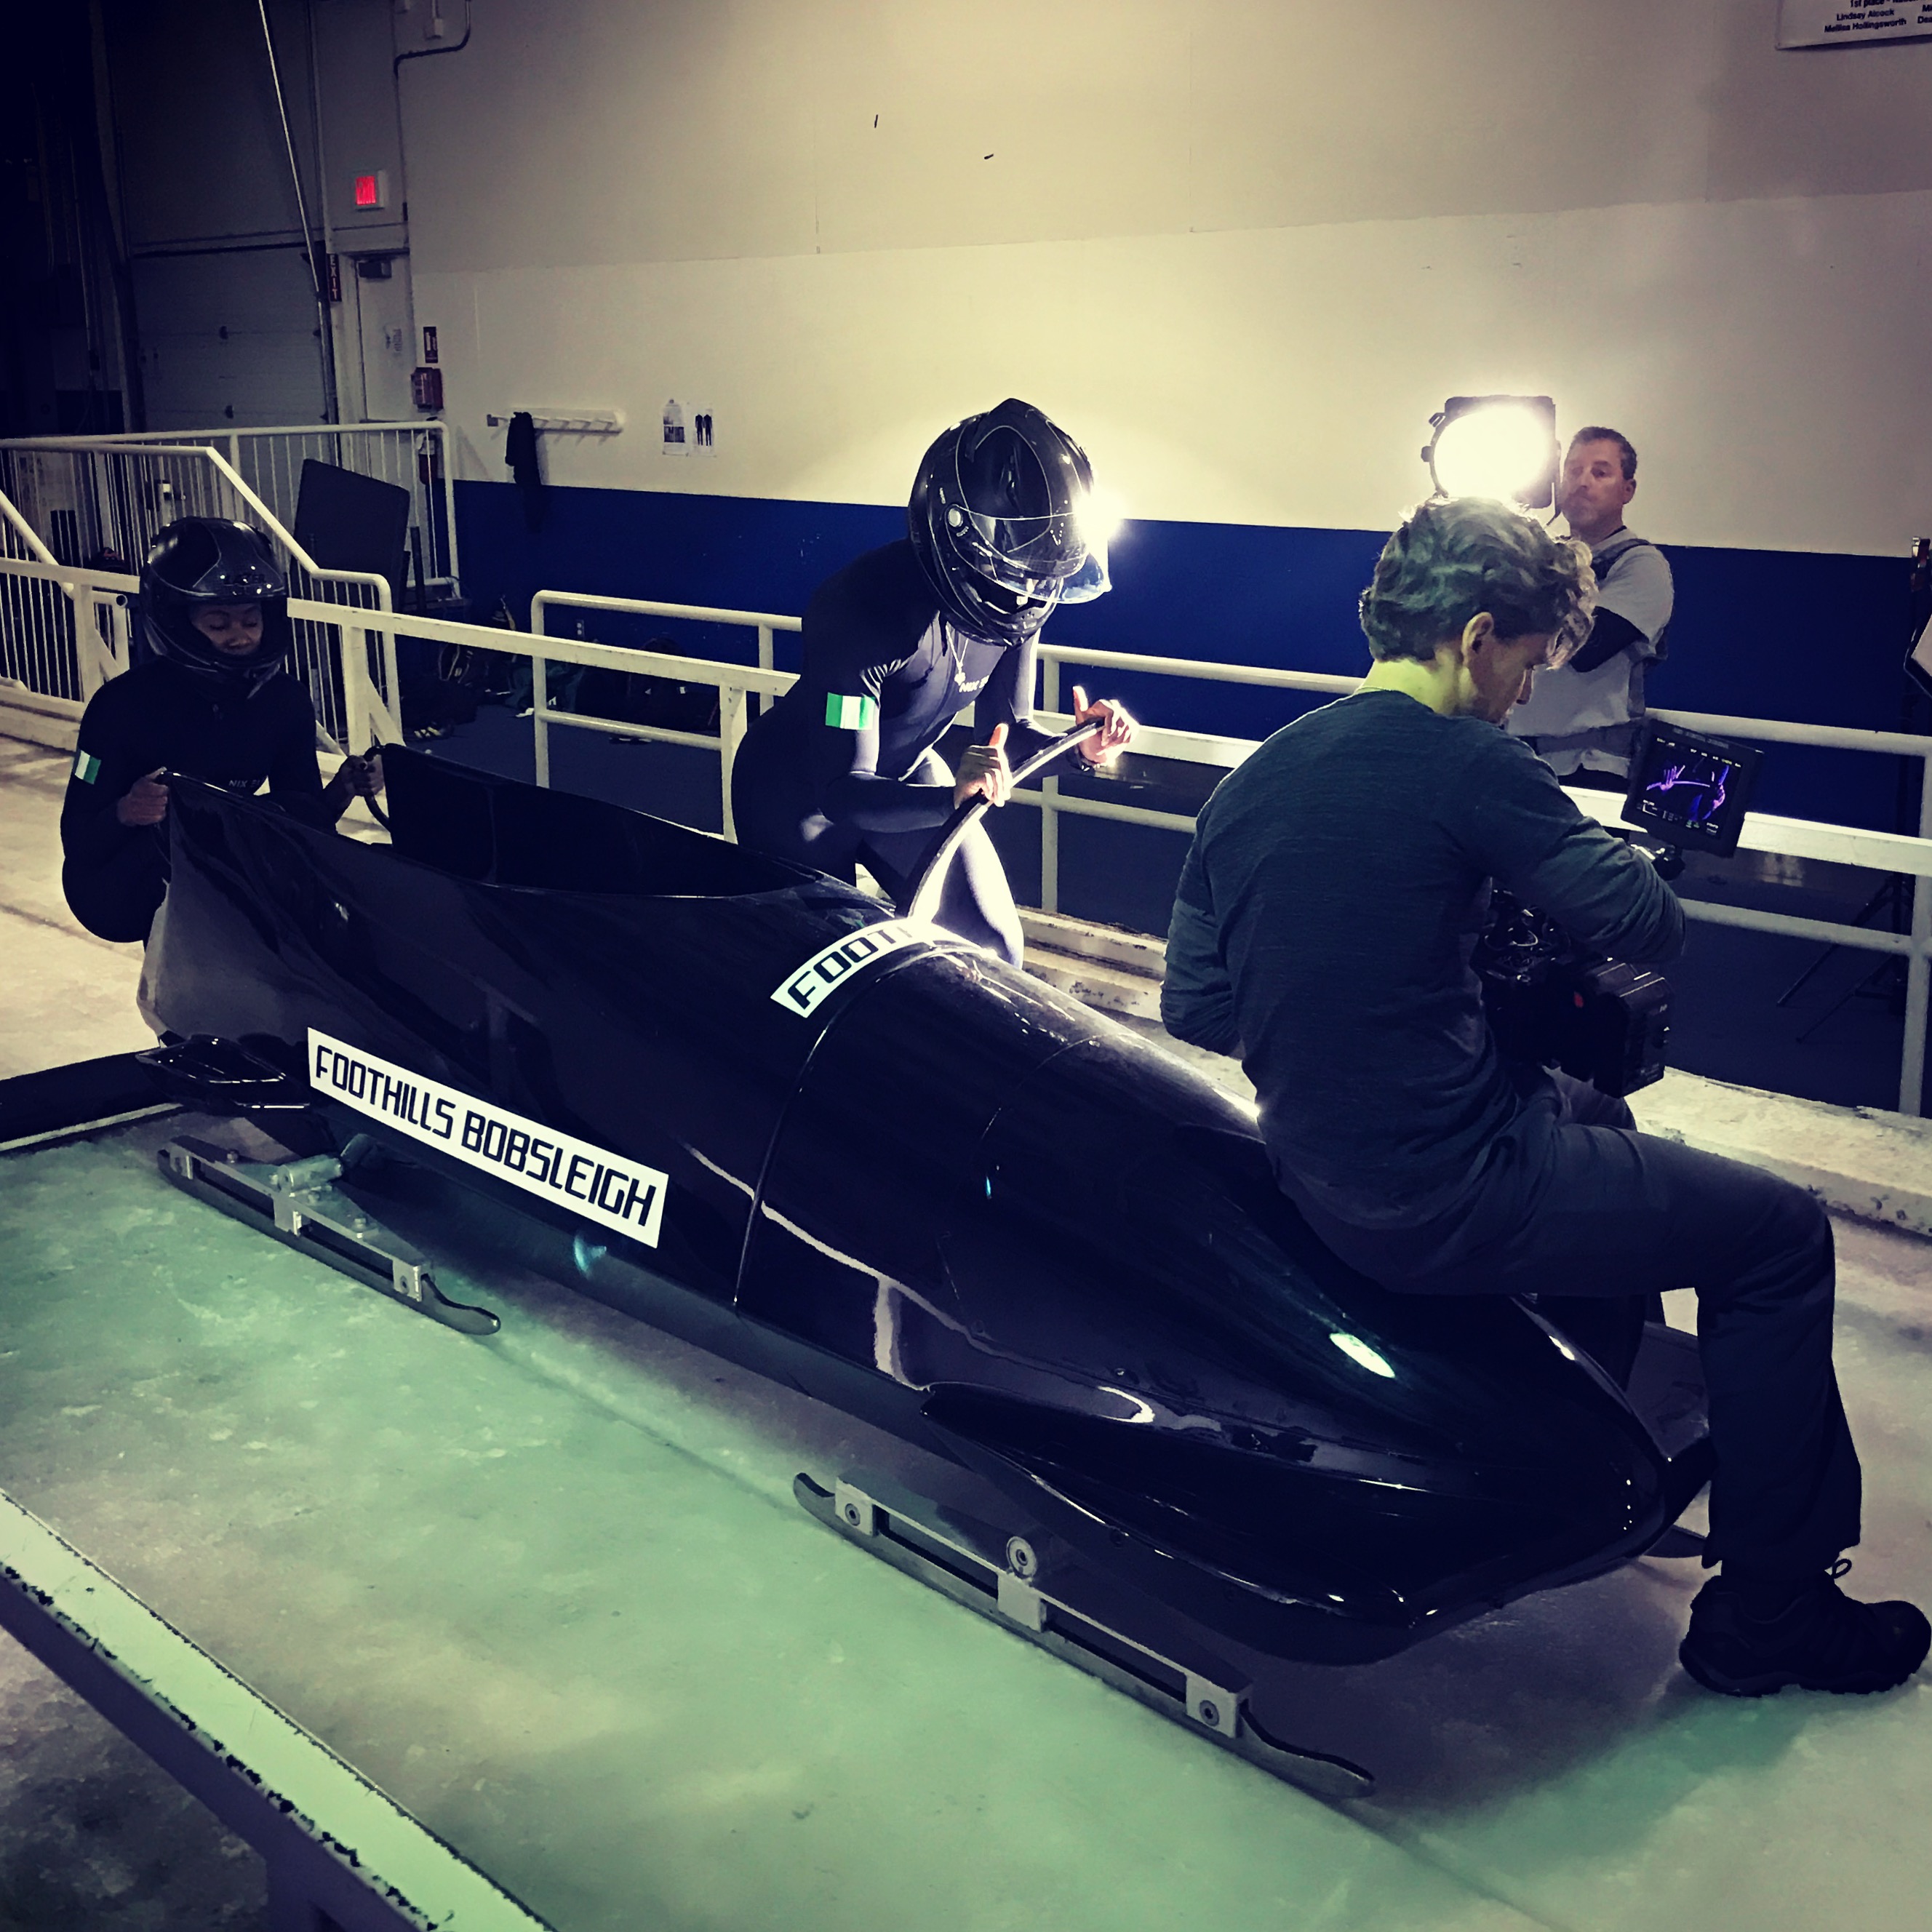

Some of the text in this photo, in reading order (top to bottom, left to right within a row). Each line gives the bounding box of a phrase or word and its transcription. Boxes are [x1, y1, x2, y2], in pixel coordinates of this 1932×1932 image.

[1836, 9, 1894, 21] Lindsay Alcock
[1852, 17, 1907, 29] Hollingsworth
[330, 255, 338, 300] EXIT
[228, 780, 248, 788] NIX
[316, 1045, 656, 1226] FOOTHILLS BOBSLEIGH
